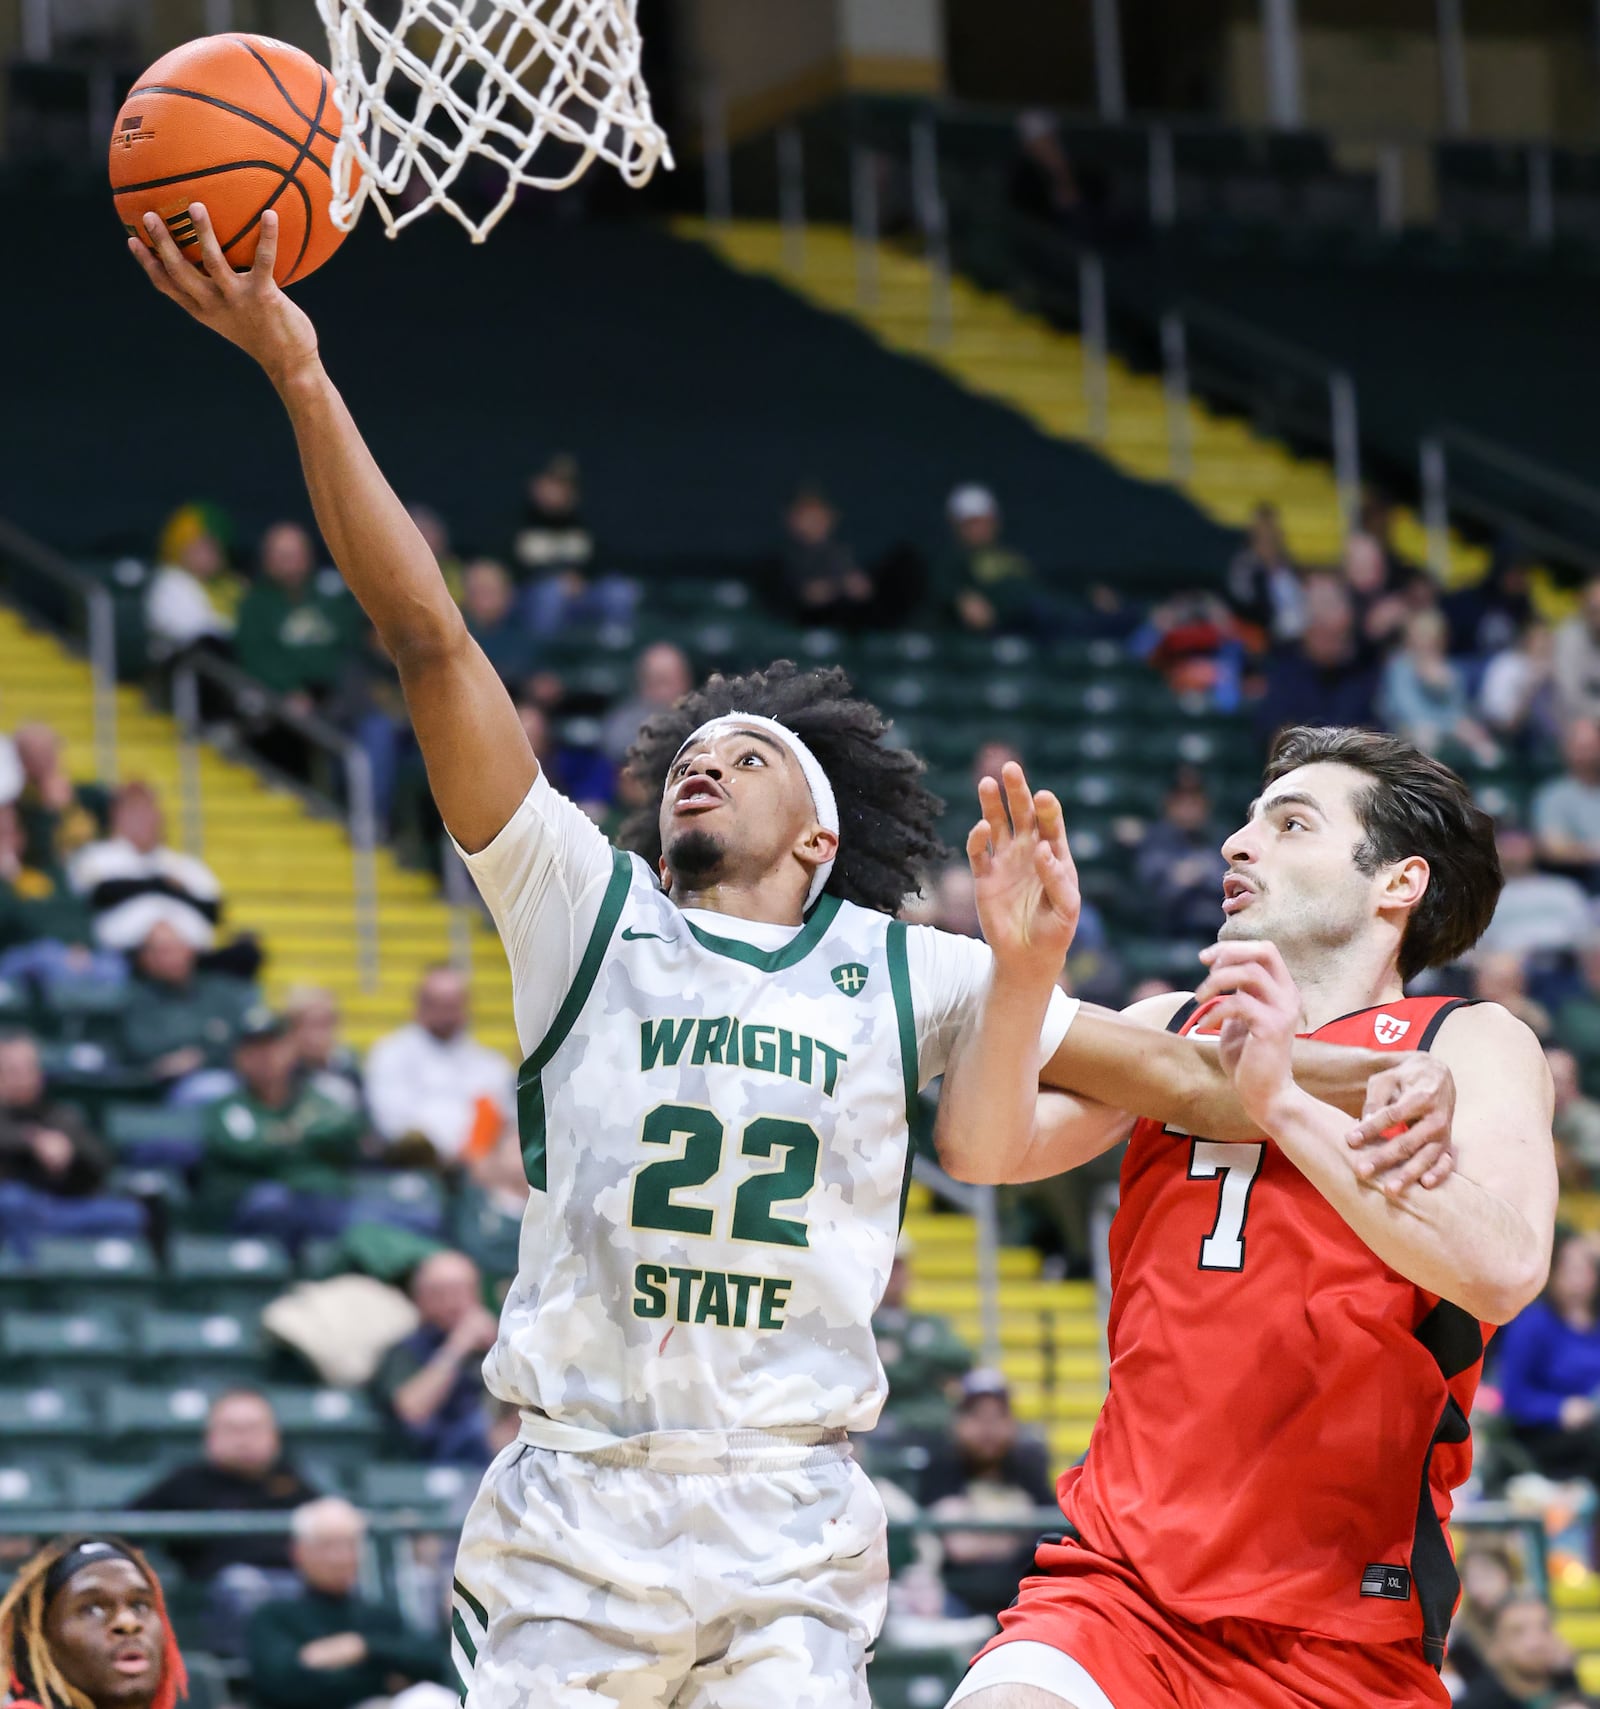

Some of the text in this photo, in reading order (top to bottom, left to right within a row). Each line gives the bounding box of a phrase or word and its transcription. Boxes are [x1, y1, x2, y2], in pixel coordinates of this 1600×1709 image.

[639, 1015, 848, 1098] WRIGHT
[629, 1103, 822, 1248] 22
[1187, 1137, 1267, 1272] 7
[632, 1262, 793, 1330] STATE
[1387, 1576, 1402, 1589] XXL
